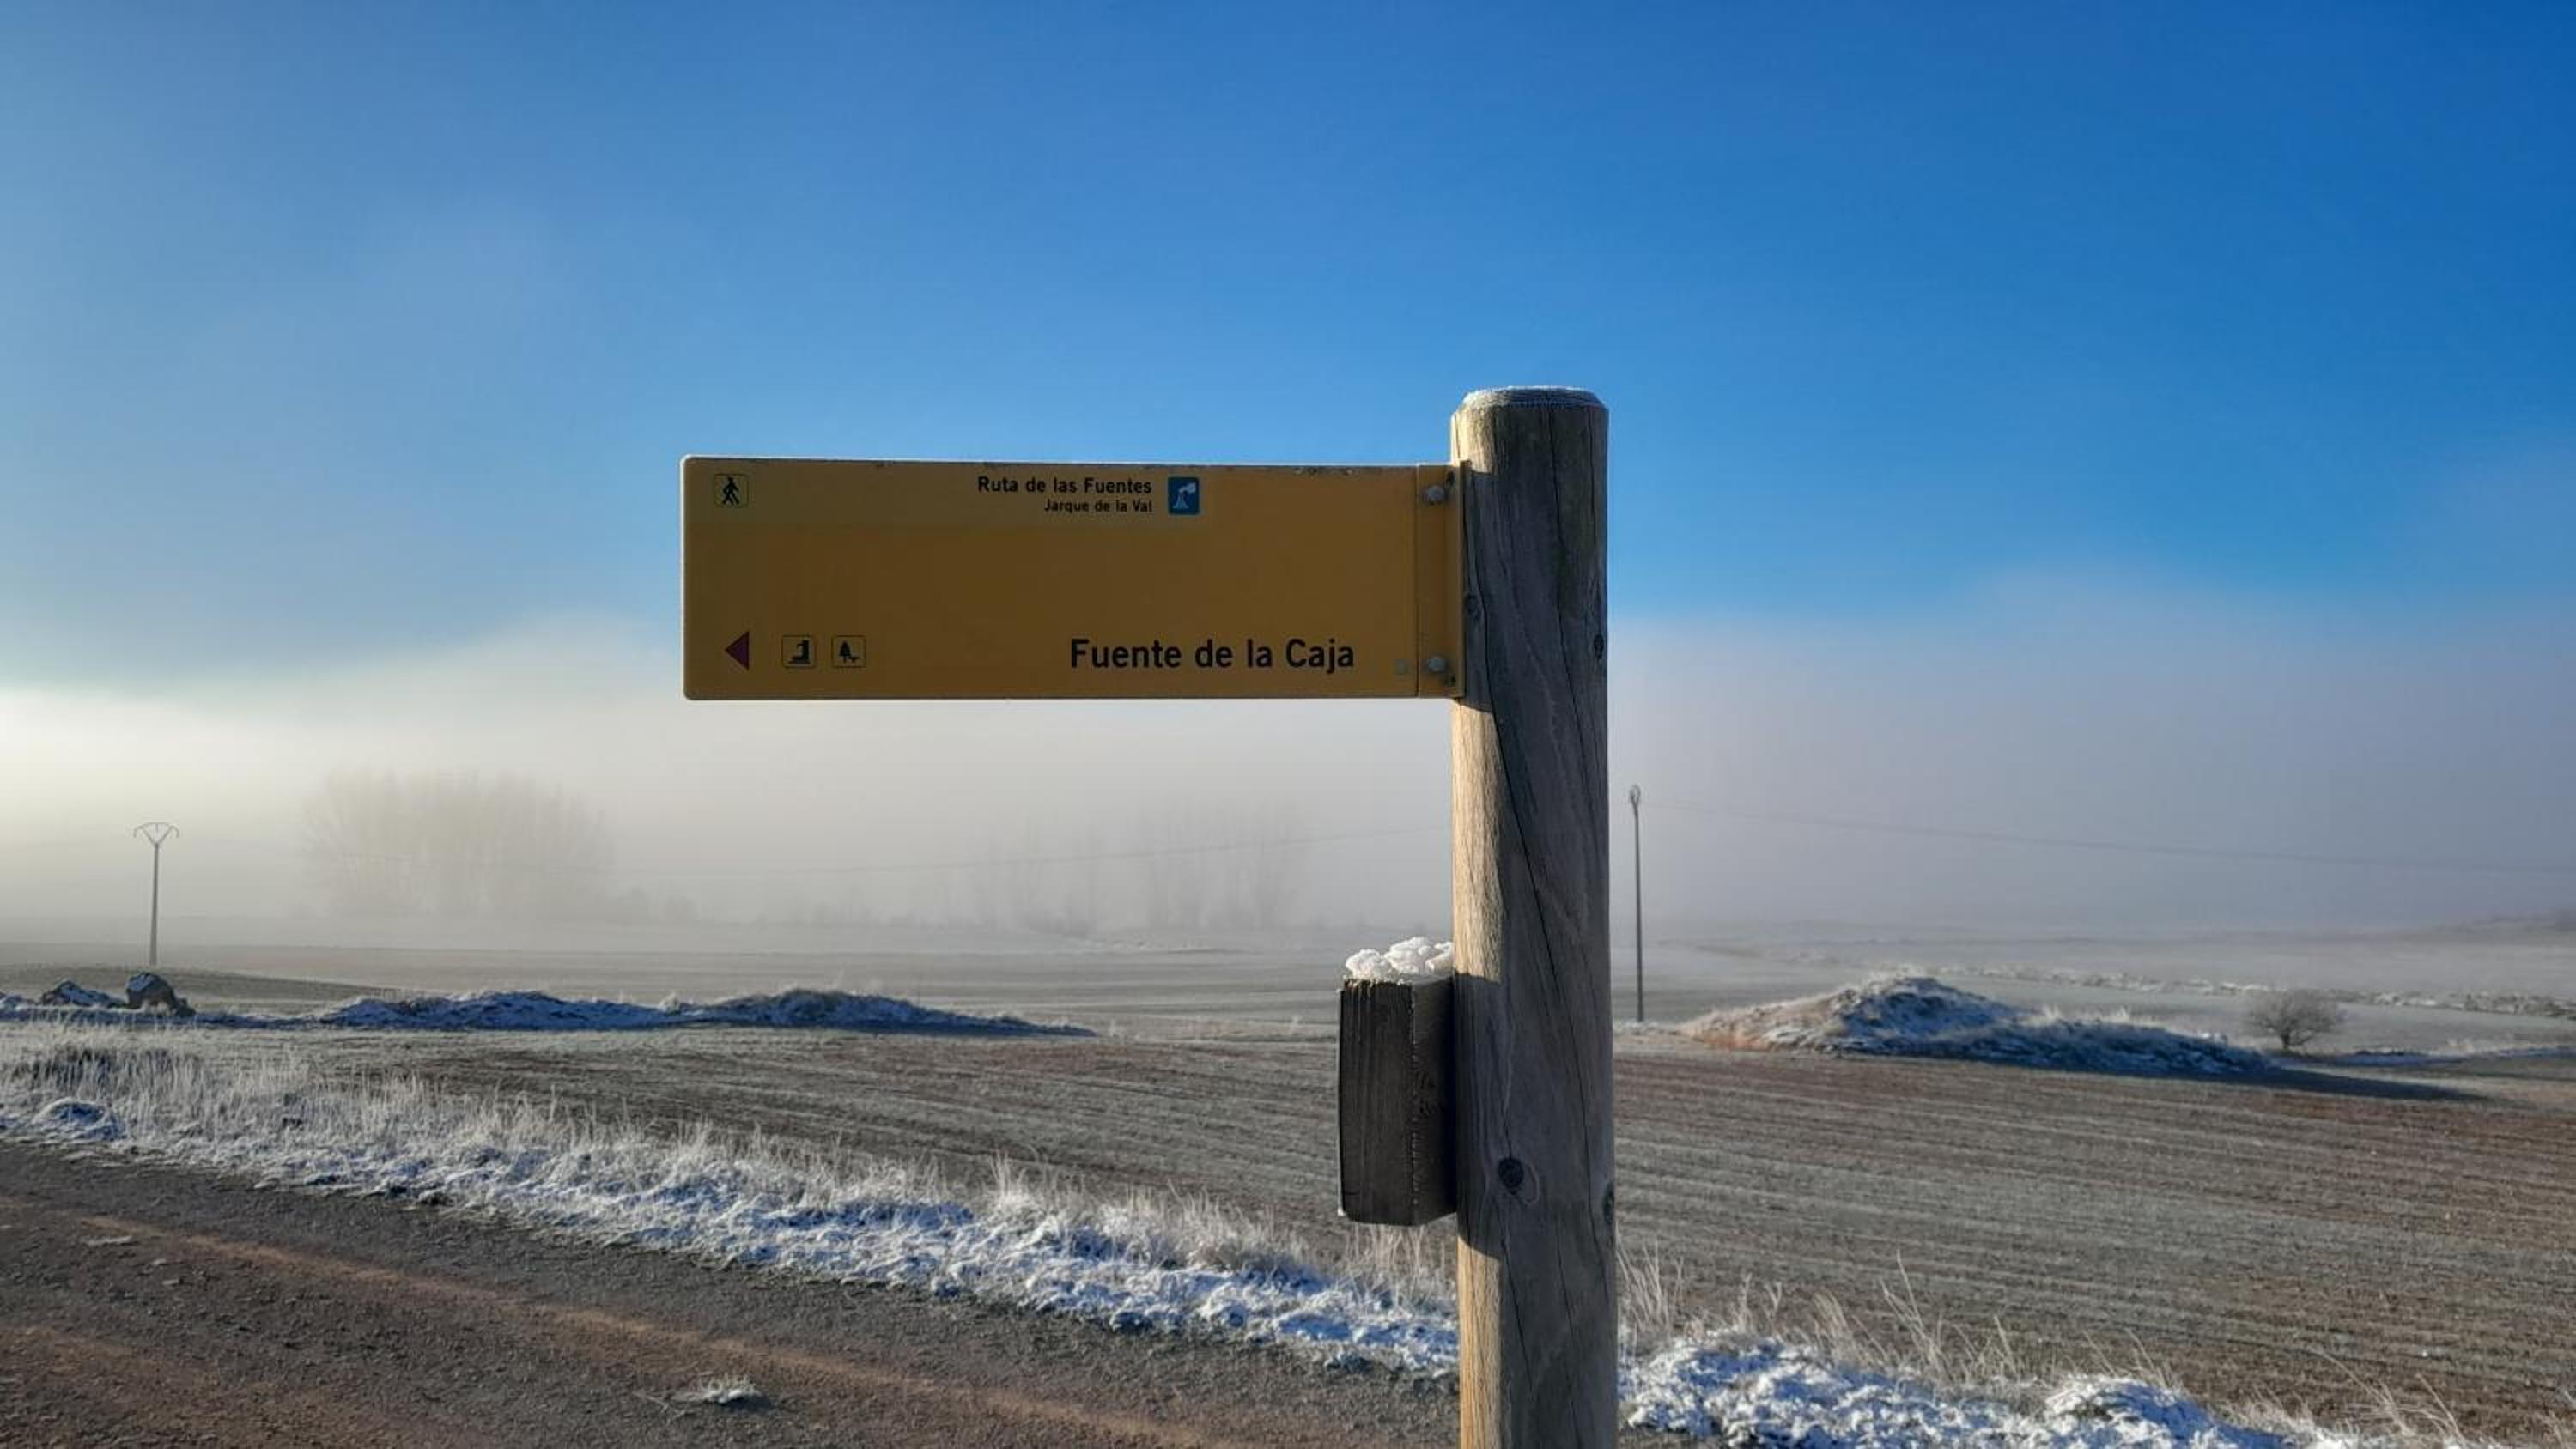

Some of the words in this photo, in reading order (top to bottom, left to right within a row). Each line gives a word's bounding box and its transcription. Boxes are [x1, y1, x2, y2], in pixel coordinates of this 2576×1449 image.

[977, 476, 1018, 493] Ruta
[1025, 476, 1046, 493] de
[1054, 476, 1077, 494] las
[1084, 477, 1152, 494] Fuentes
[1044, 499, 1090, 513] Jarque
[1095, 499, 1110, 512] de
[1115, 499, 1128, 512] la
[1133, 499, 1152, 512] Val
[1070, 638, 1182, 669] Fuente
[1194, 638, 1233, 669] de
[1247, 638, 1273, 669] la
[1285, 638, 1355, 674] Caja
